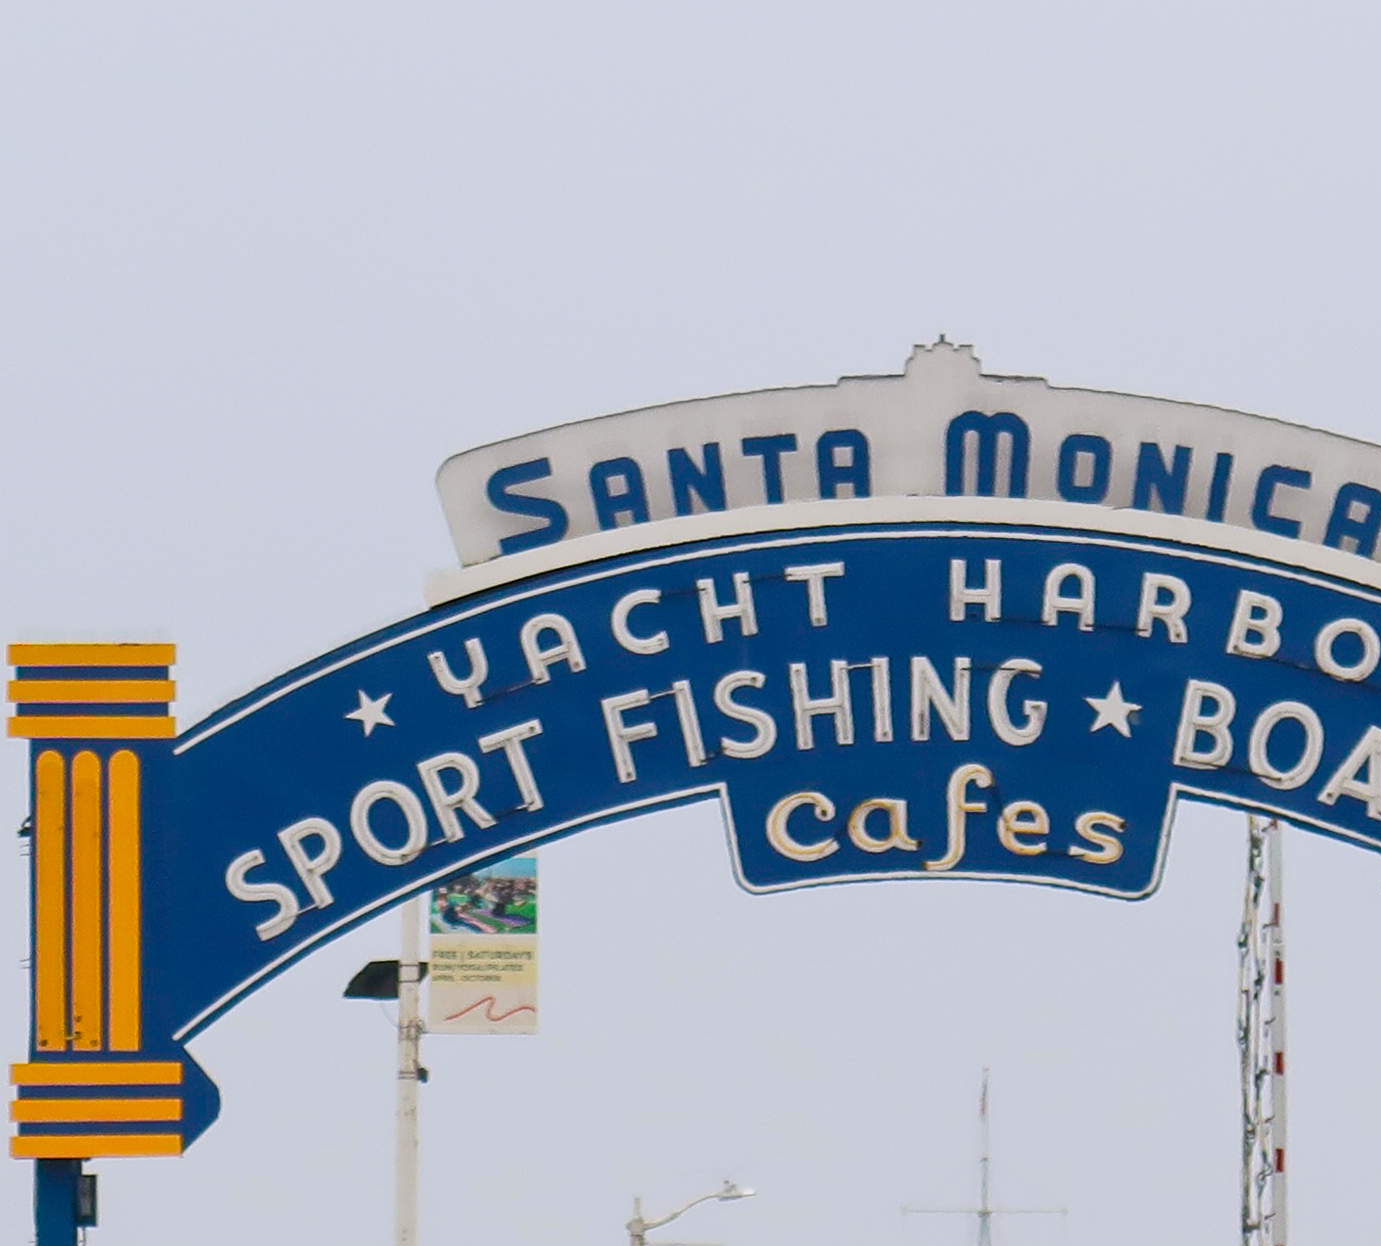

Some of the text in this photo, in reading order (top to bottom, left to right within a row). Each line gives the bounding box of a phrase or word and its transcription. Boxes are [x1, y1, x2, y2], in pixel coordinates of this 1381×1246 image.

[485, 428, 872, 556] SANTA
[428, 561, 845, 709] YACHT
[224, 719, 544, 942] SPORT
[601, 656, 1048, 782] FISHING
